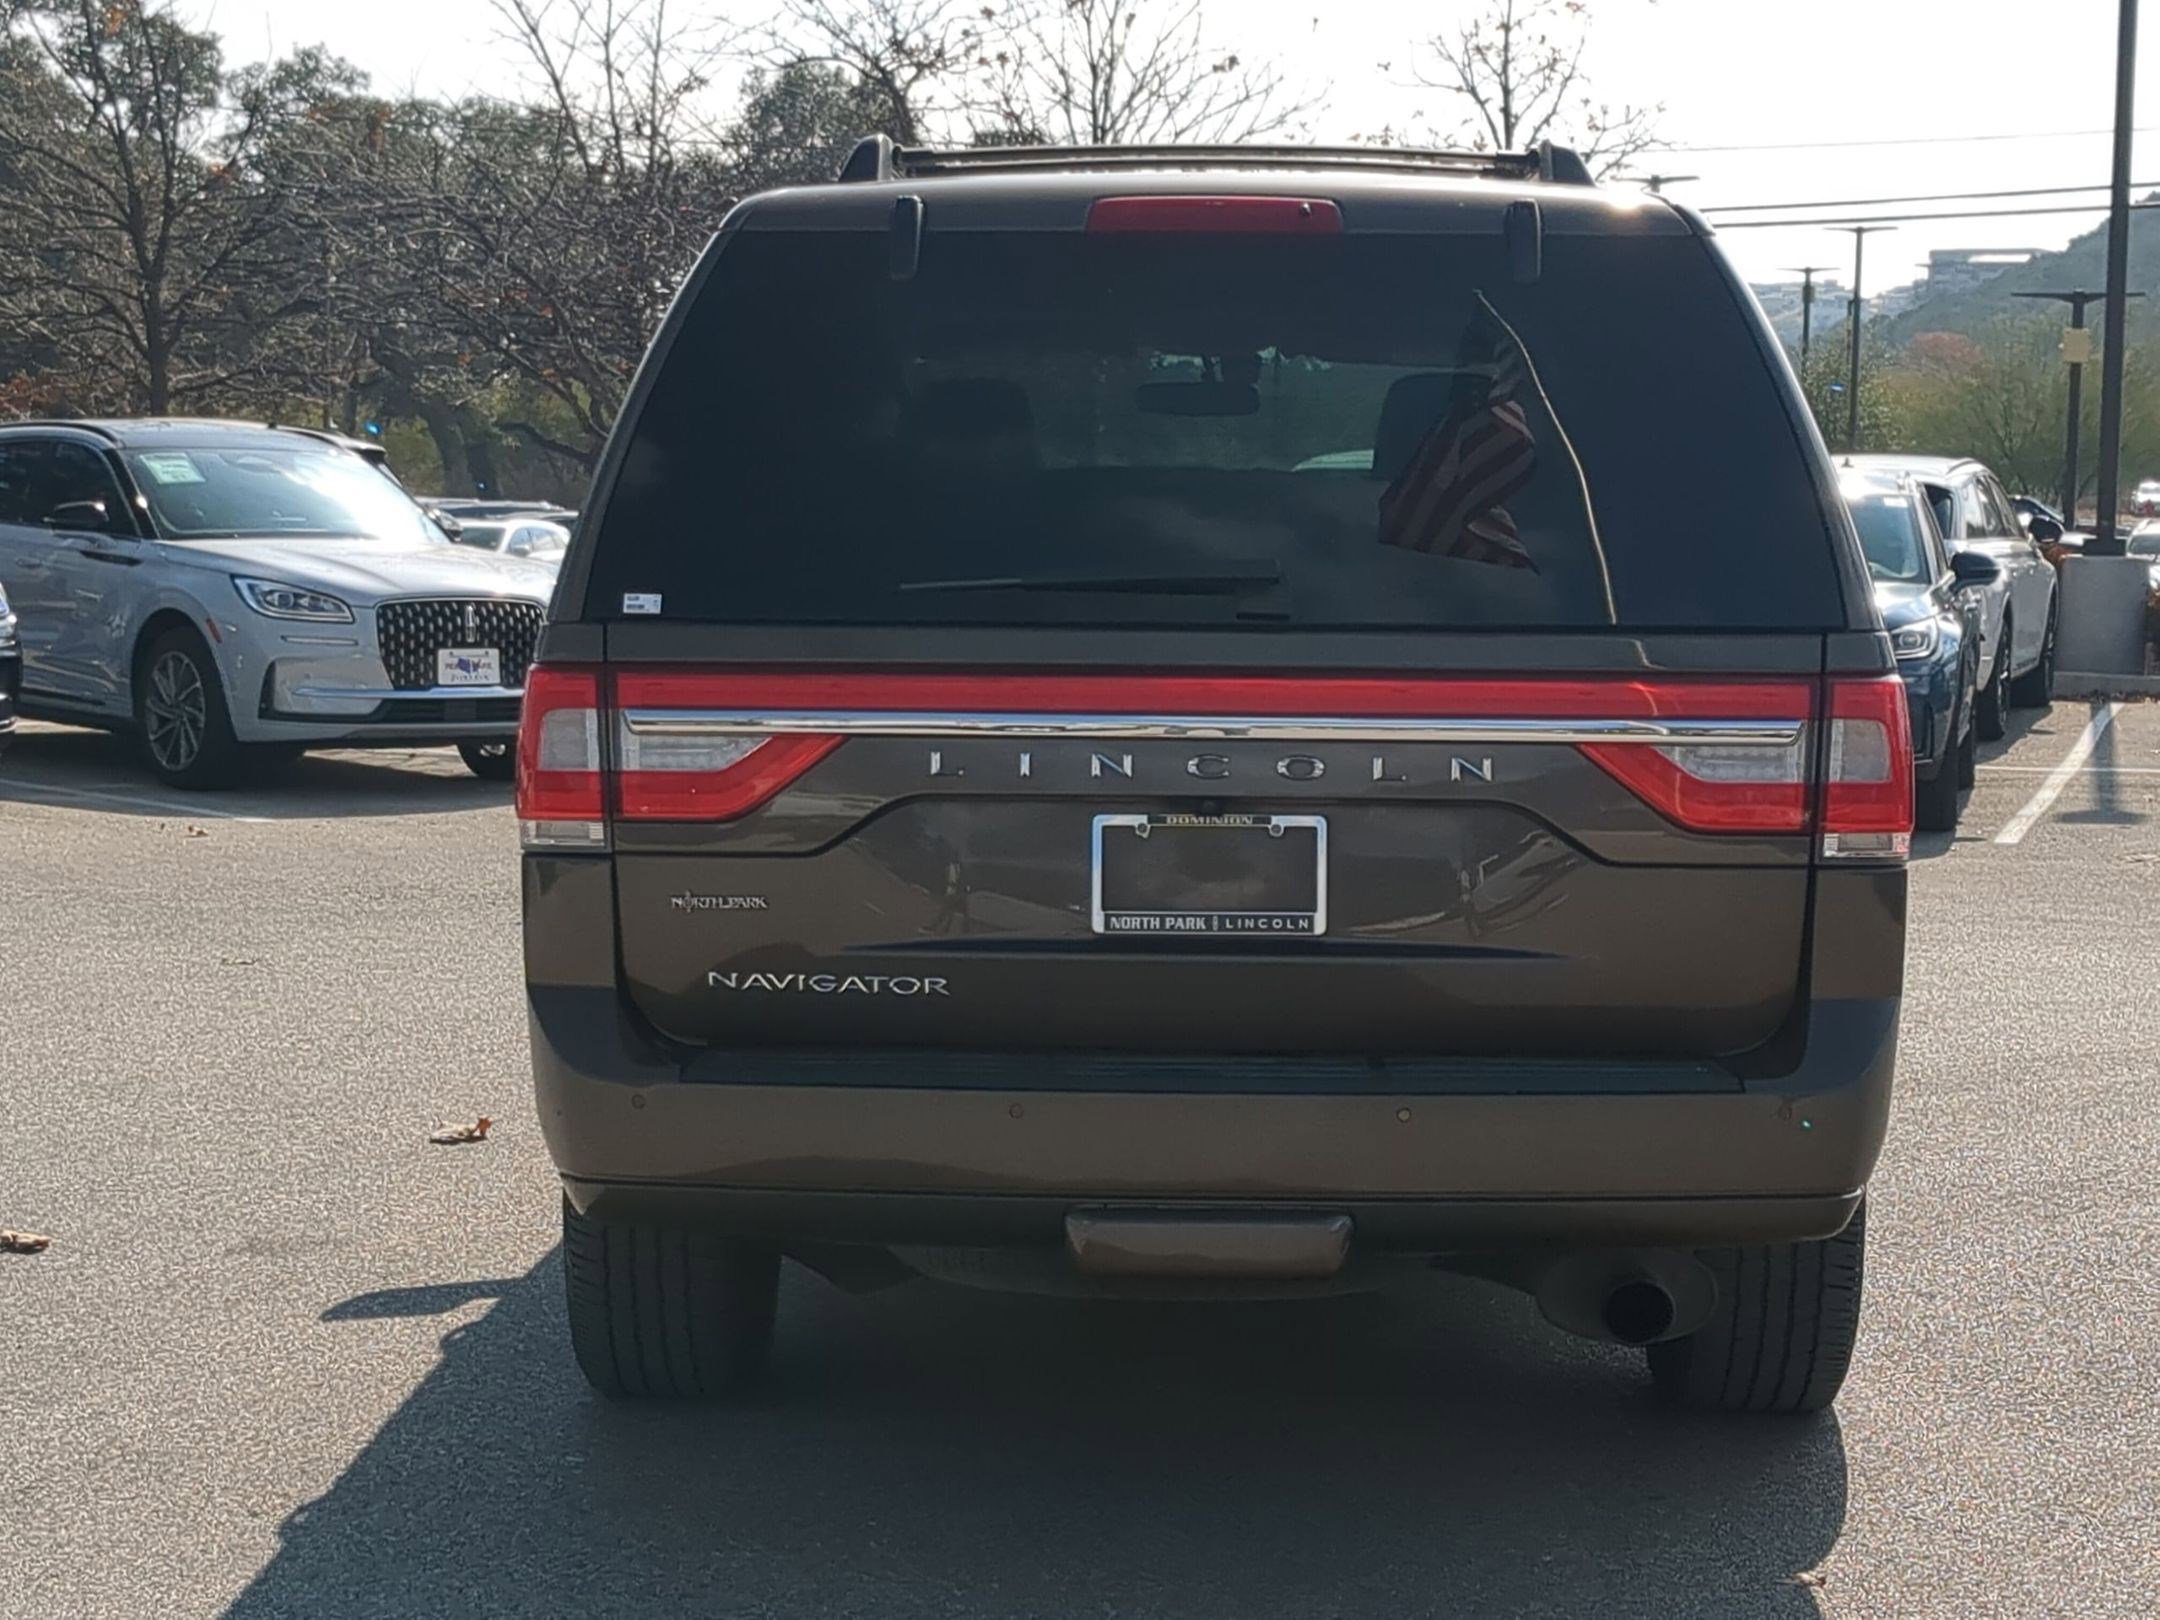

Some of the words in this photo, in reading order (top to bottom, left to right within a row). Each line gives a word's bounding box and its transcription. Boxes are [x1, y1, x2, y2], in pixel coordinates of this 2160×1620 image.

[929, 750, 1494, 783] LINCOLN
[1166, 815, 1253, 824] DOMINION
[1110, 916, 1160, 930] NORTH
[1165, 916, 1207, 930] PARK
[1225, 918, 1309, 929] LINCOLN
[707, 971, 951, 996] NAVIGATOR
